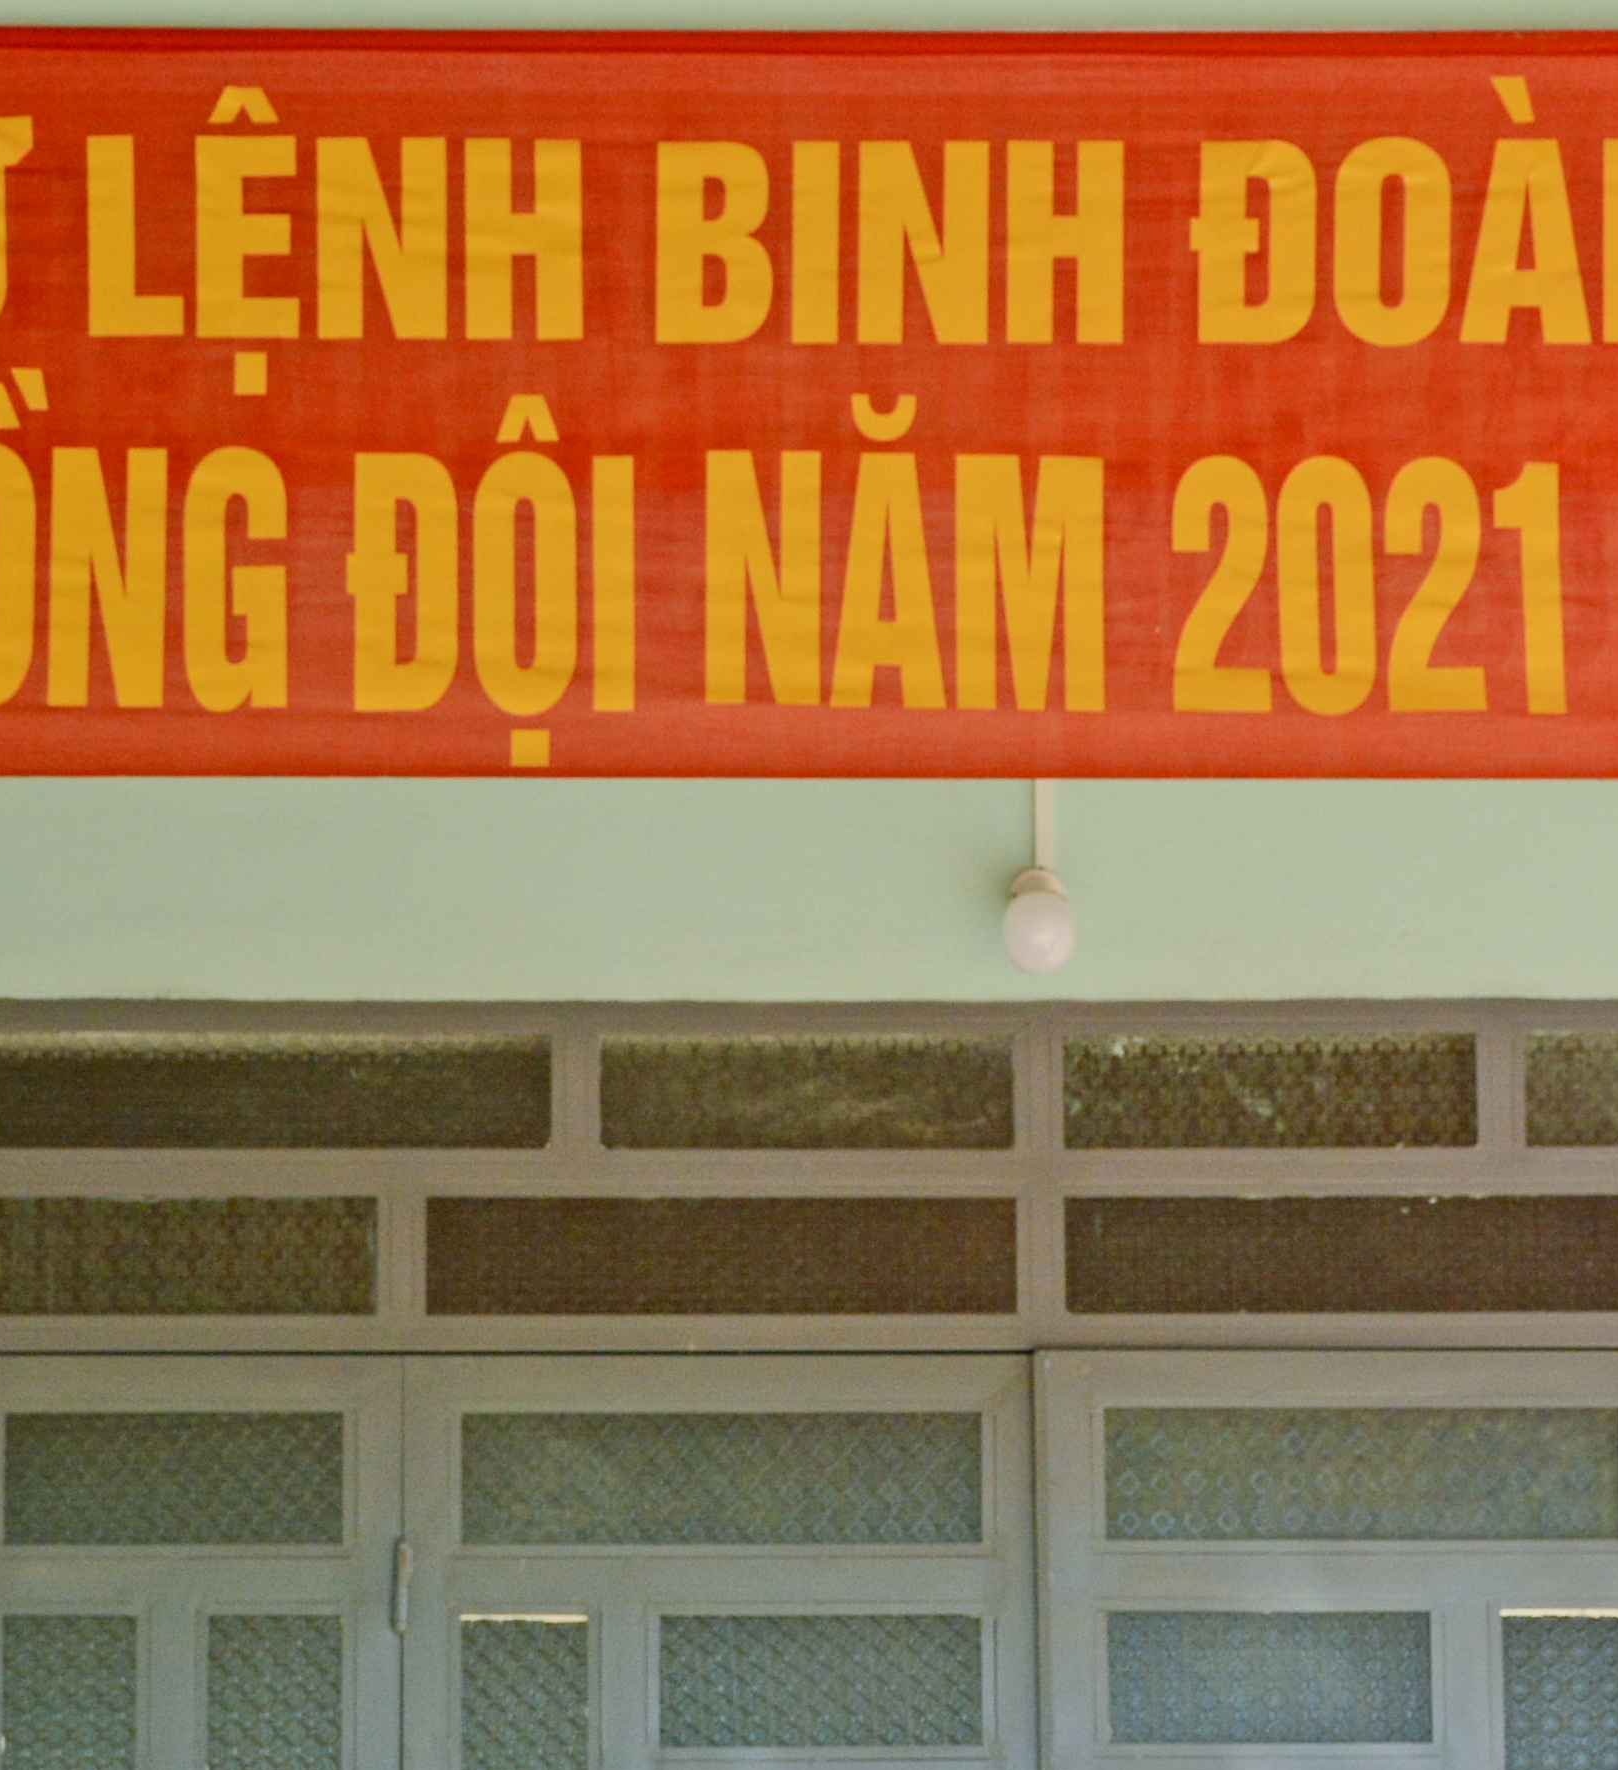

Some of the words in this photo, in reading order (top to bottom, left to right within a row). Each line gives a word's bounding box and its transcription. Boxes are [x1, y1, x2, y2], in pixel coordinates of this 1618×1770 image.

[87, 86, 583, 396] LỆNH
[656, 140, 1124, 345] BINH
[346, 394, 635, 768] ĐỘI
[705, 394, 1105, 713] NĂM
[1172, 456, 1567, 717] 2021
